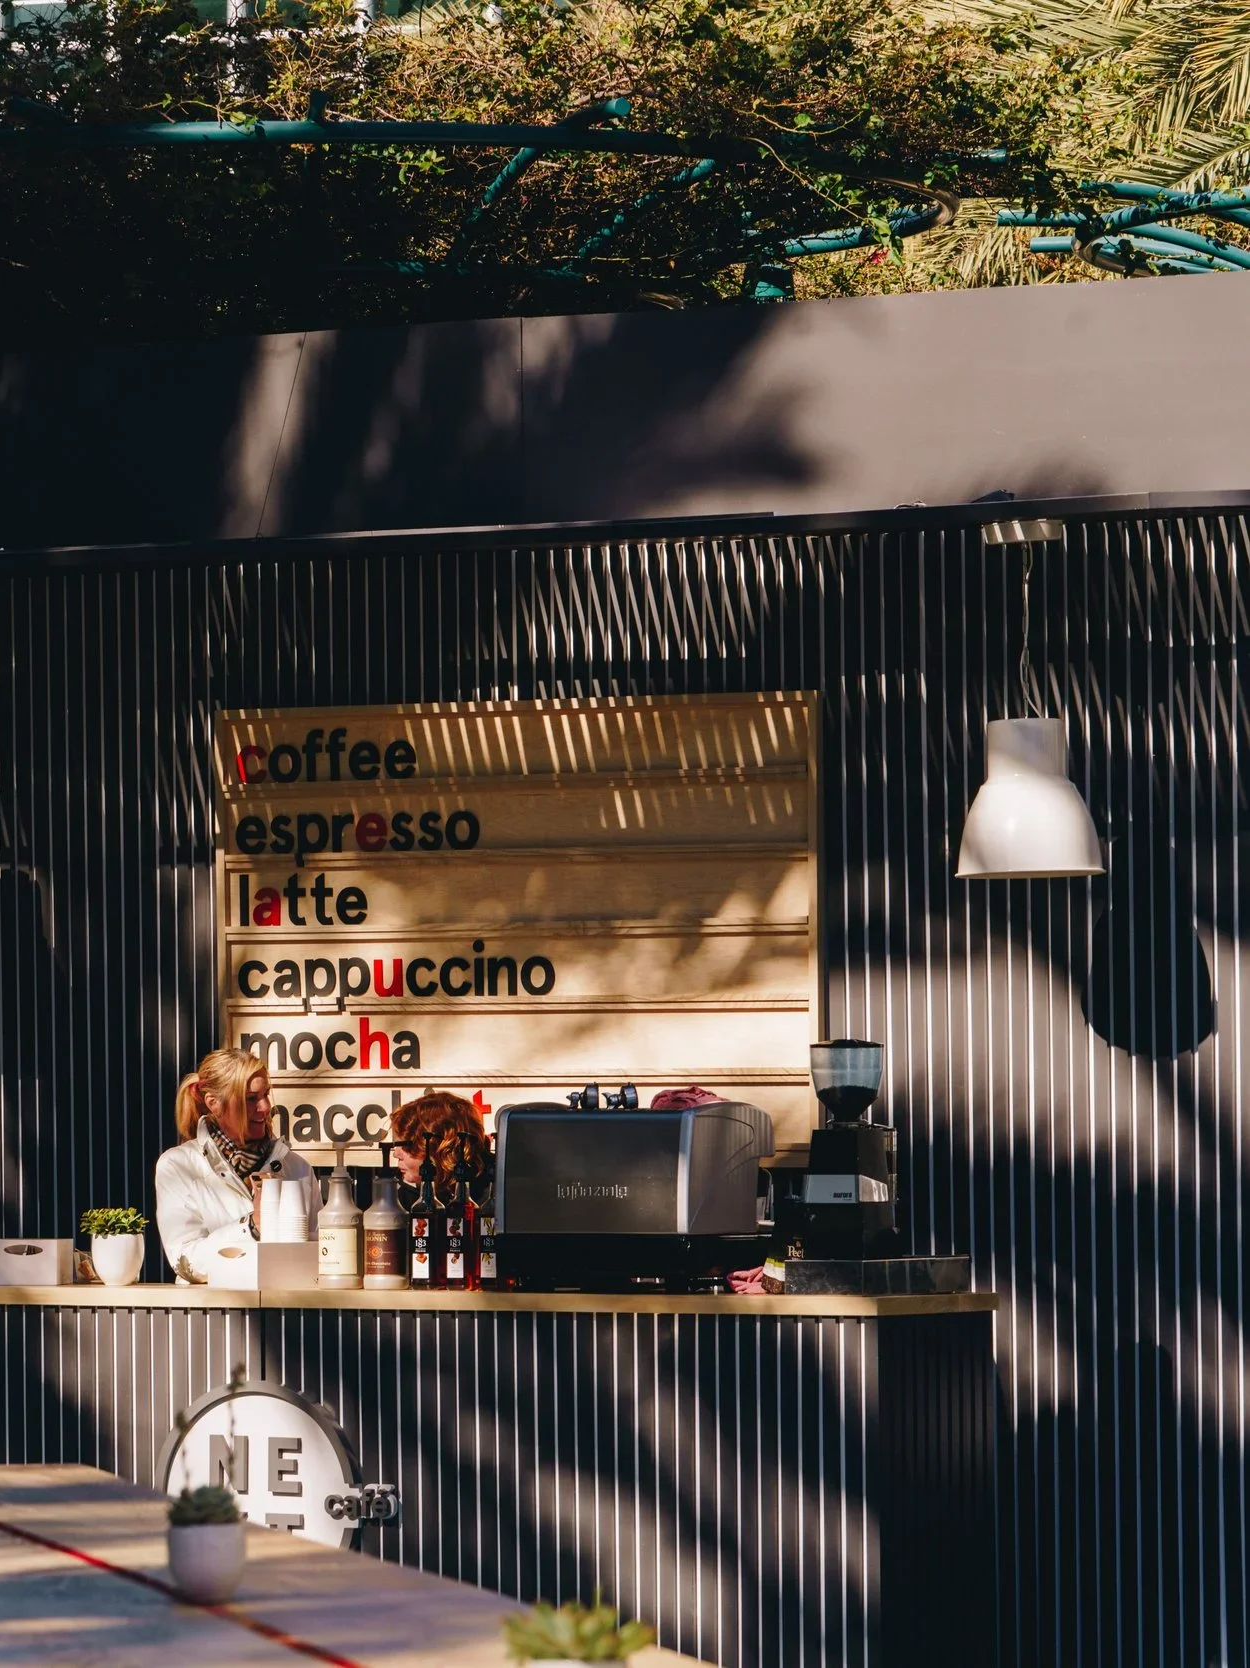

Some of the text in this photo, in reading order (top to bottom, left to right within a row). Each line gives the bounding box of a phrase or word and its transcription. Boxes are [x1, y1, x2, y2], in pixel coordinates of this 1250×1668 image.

[237, 728, 417, 784] coffee
[235, 810, 480, 867] espresso
[239, 873, 368, 927] latte
[238, 940, 556, 1012] cappuccino
[240, 1017, 421, 1070] mocha
[209, 1434, 303, 1497] NE
